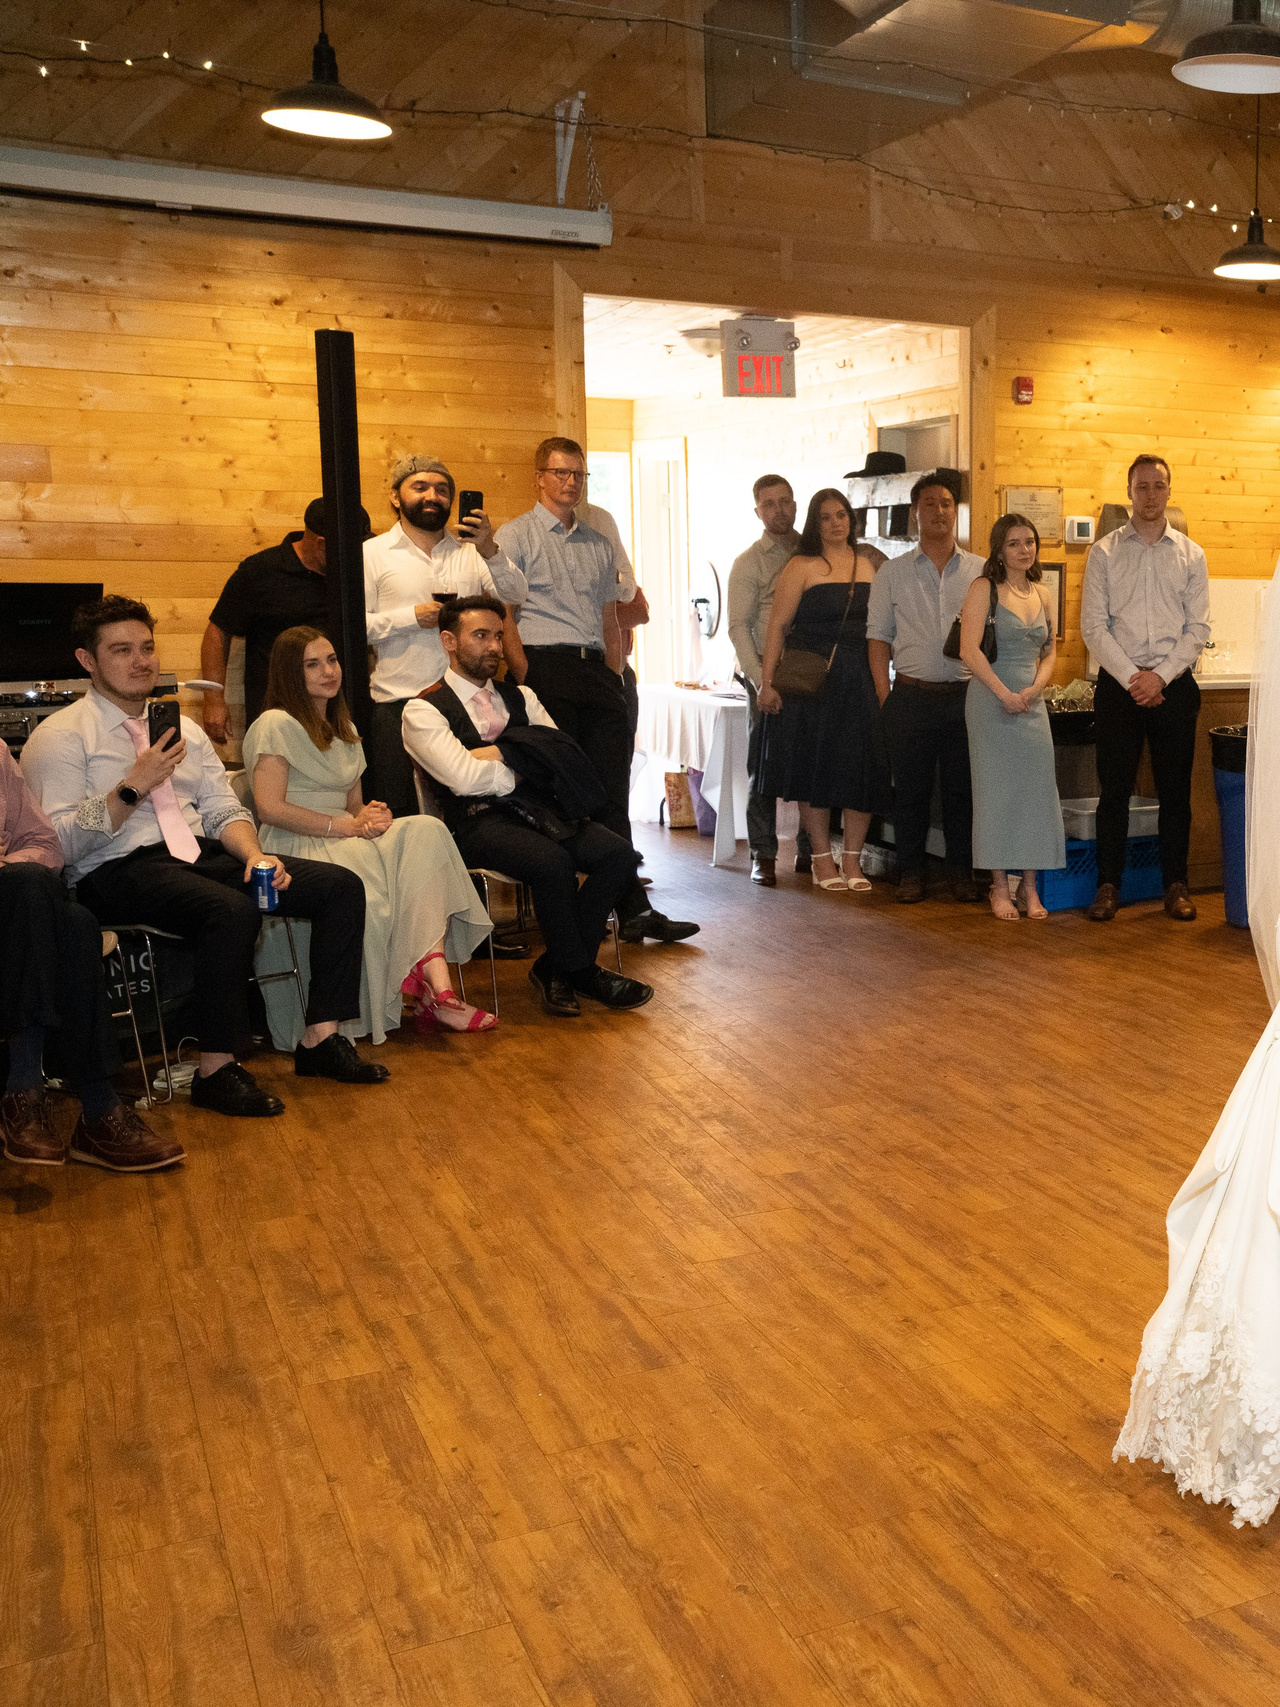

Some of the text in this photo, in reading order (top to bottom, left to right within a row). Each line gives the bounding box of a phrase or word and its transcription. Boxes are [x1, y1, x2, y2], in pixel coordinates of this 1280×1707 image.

[737, 355, 784, 394] EXIT
[102, 951, 157, 977] NIC
[106, 979, 151, 999] TES
